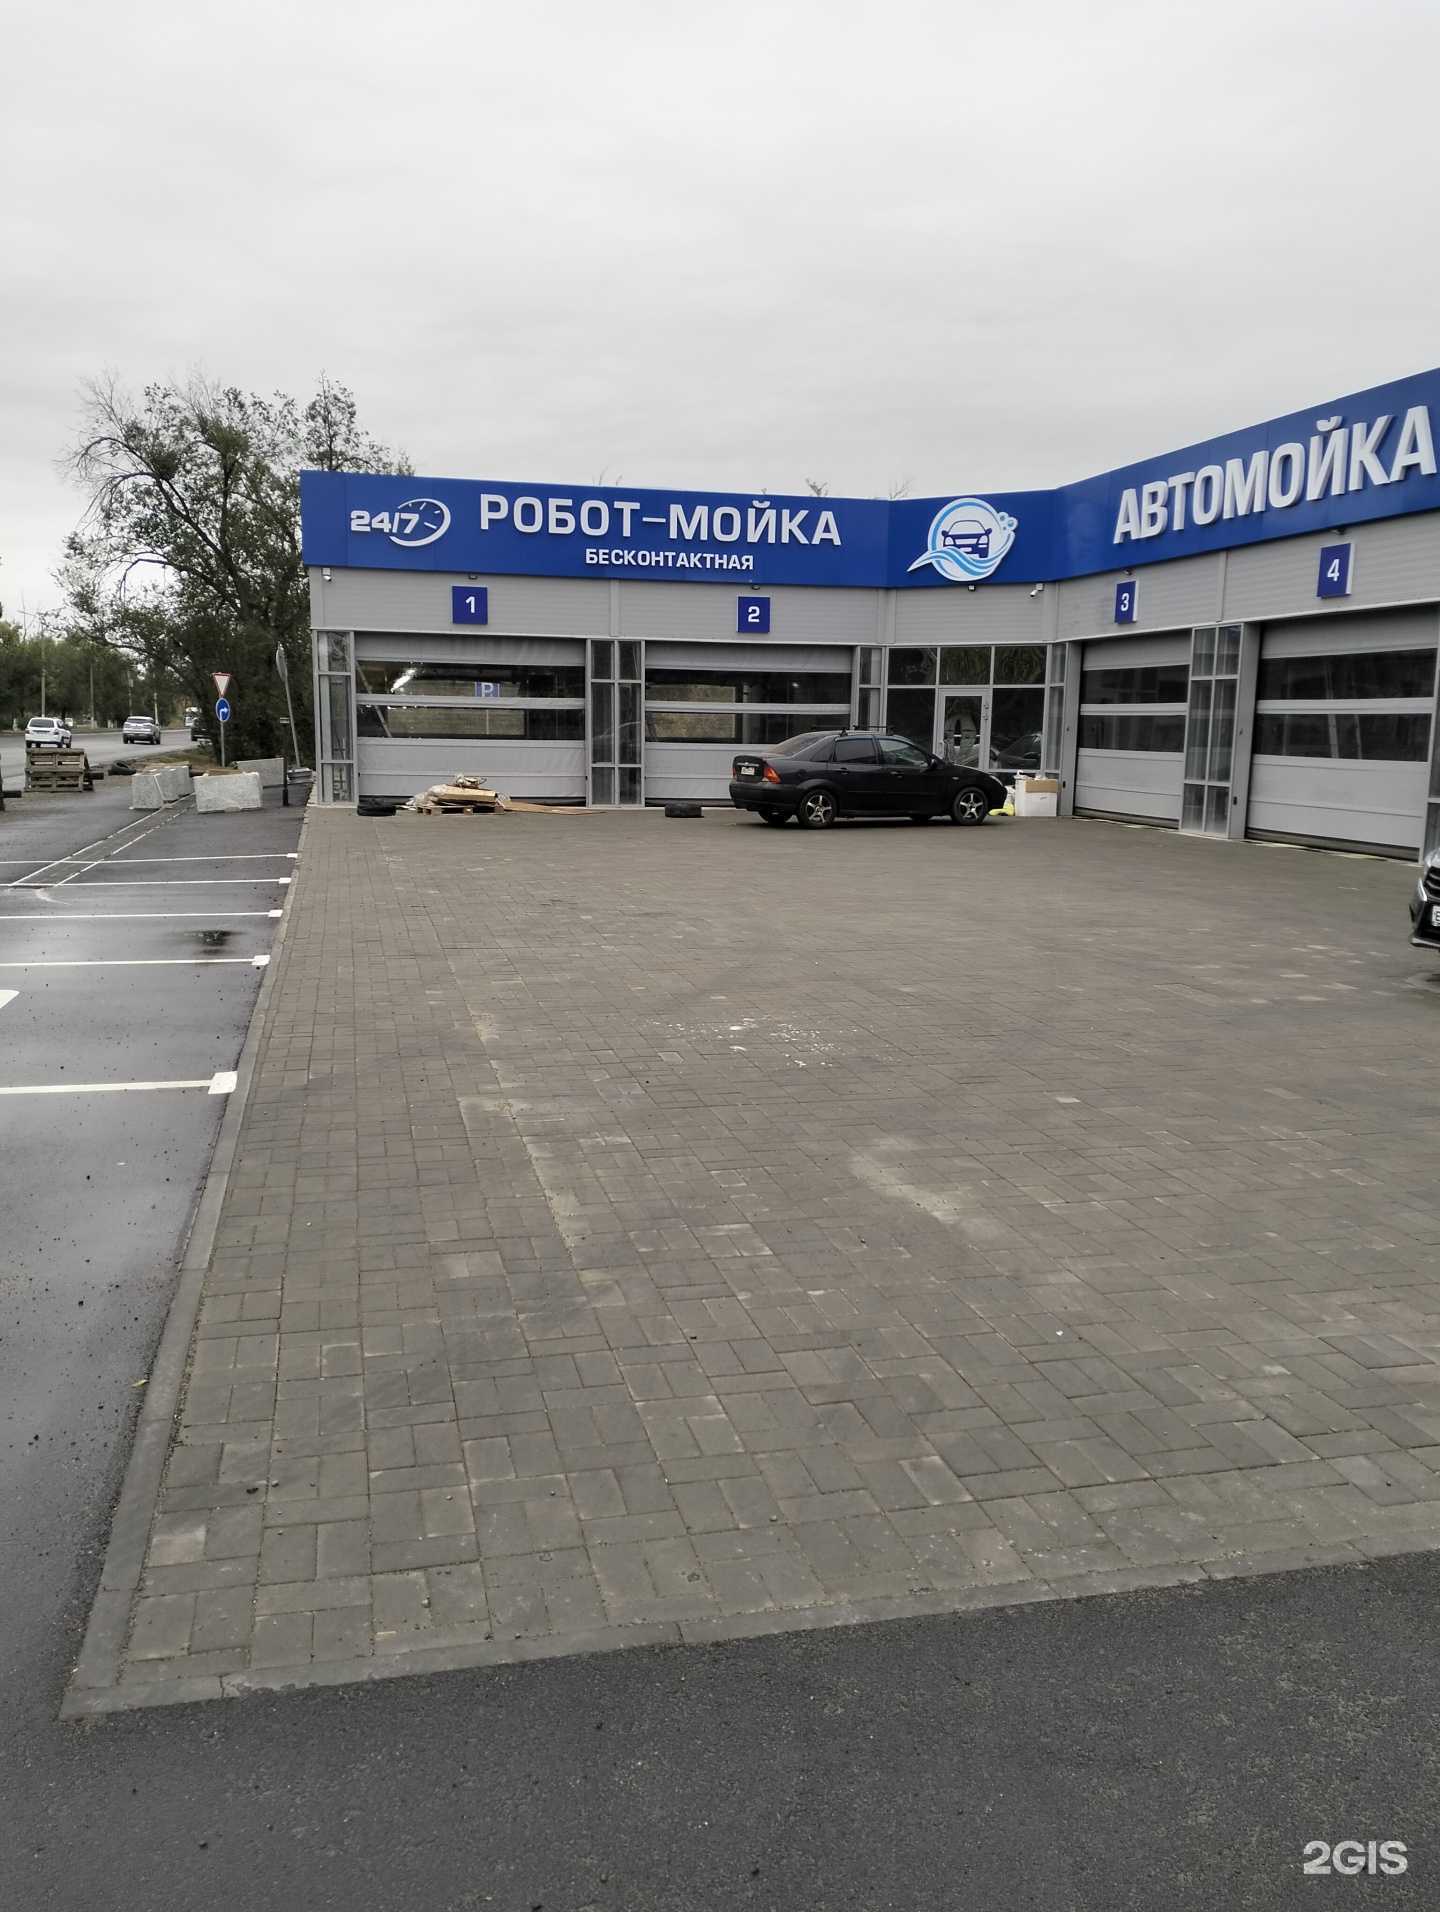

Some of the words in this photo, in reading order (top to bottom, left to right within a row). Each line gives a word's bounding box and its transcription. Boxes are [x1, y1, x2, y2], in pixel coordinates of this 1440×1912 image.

[1113, 405, 1438, 544] АВТОМОЙКА
[350, 510, 420, 534] 24/7
[479, 493, 842, 546] РОБОТ-МОЙКА
[586, 549, 754, 571] БЕСКОНТАКТНАЯ
[1326, 558, 1340, 582] 4
[465, 596, 476, 614] 1
[1120, 592, 1130, 612] 3
[748, 606, 760, 623] 2
